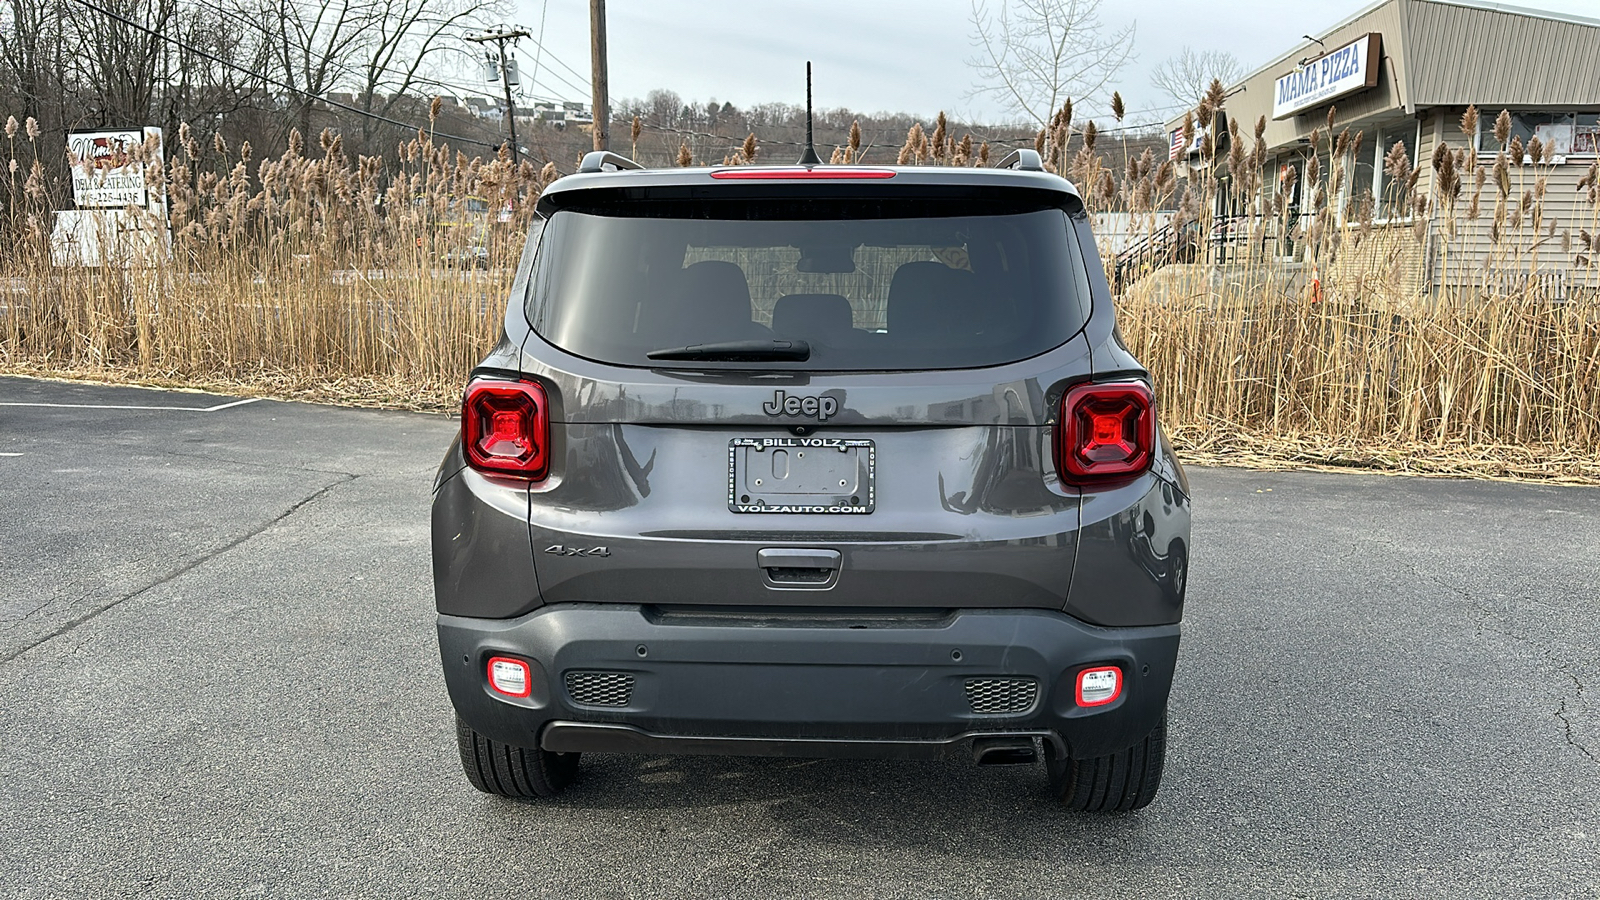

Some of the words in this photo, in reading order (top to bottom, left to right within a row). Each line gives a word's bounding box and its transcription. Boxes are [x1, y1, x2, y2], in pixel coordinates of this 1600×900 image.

[1278, 63, 1318, 106] MAMA
[1321, 43, 1359, 87] PIZZA
[763, 390, 838, 422] Jeep
[763, 438, 797, 447] BILL
[800, 438, 842, 447] VOLZ
[737, 505, 866, 513] VOLZAUTO.COM
[544, 544, 612, 558] 4x4
